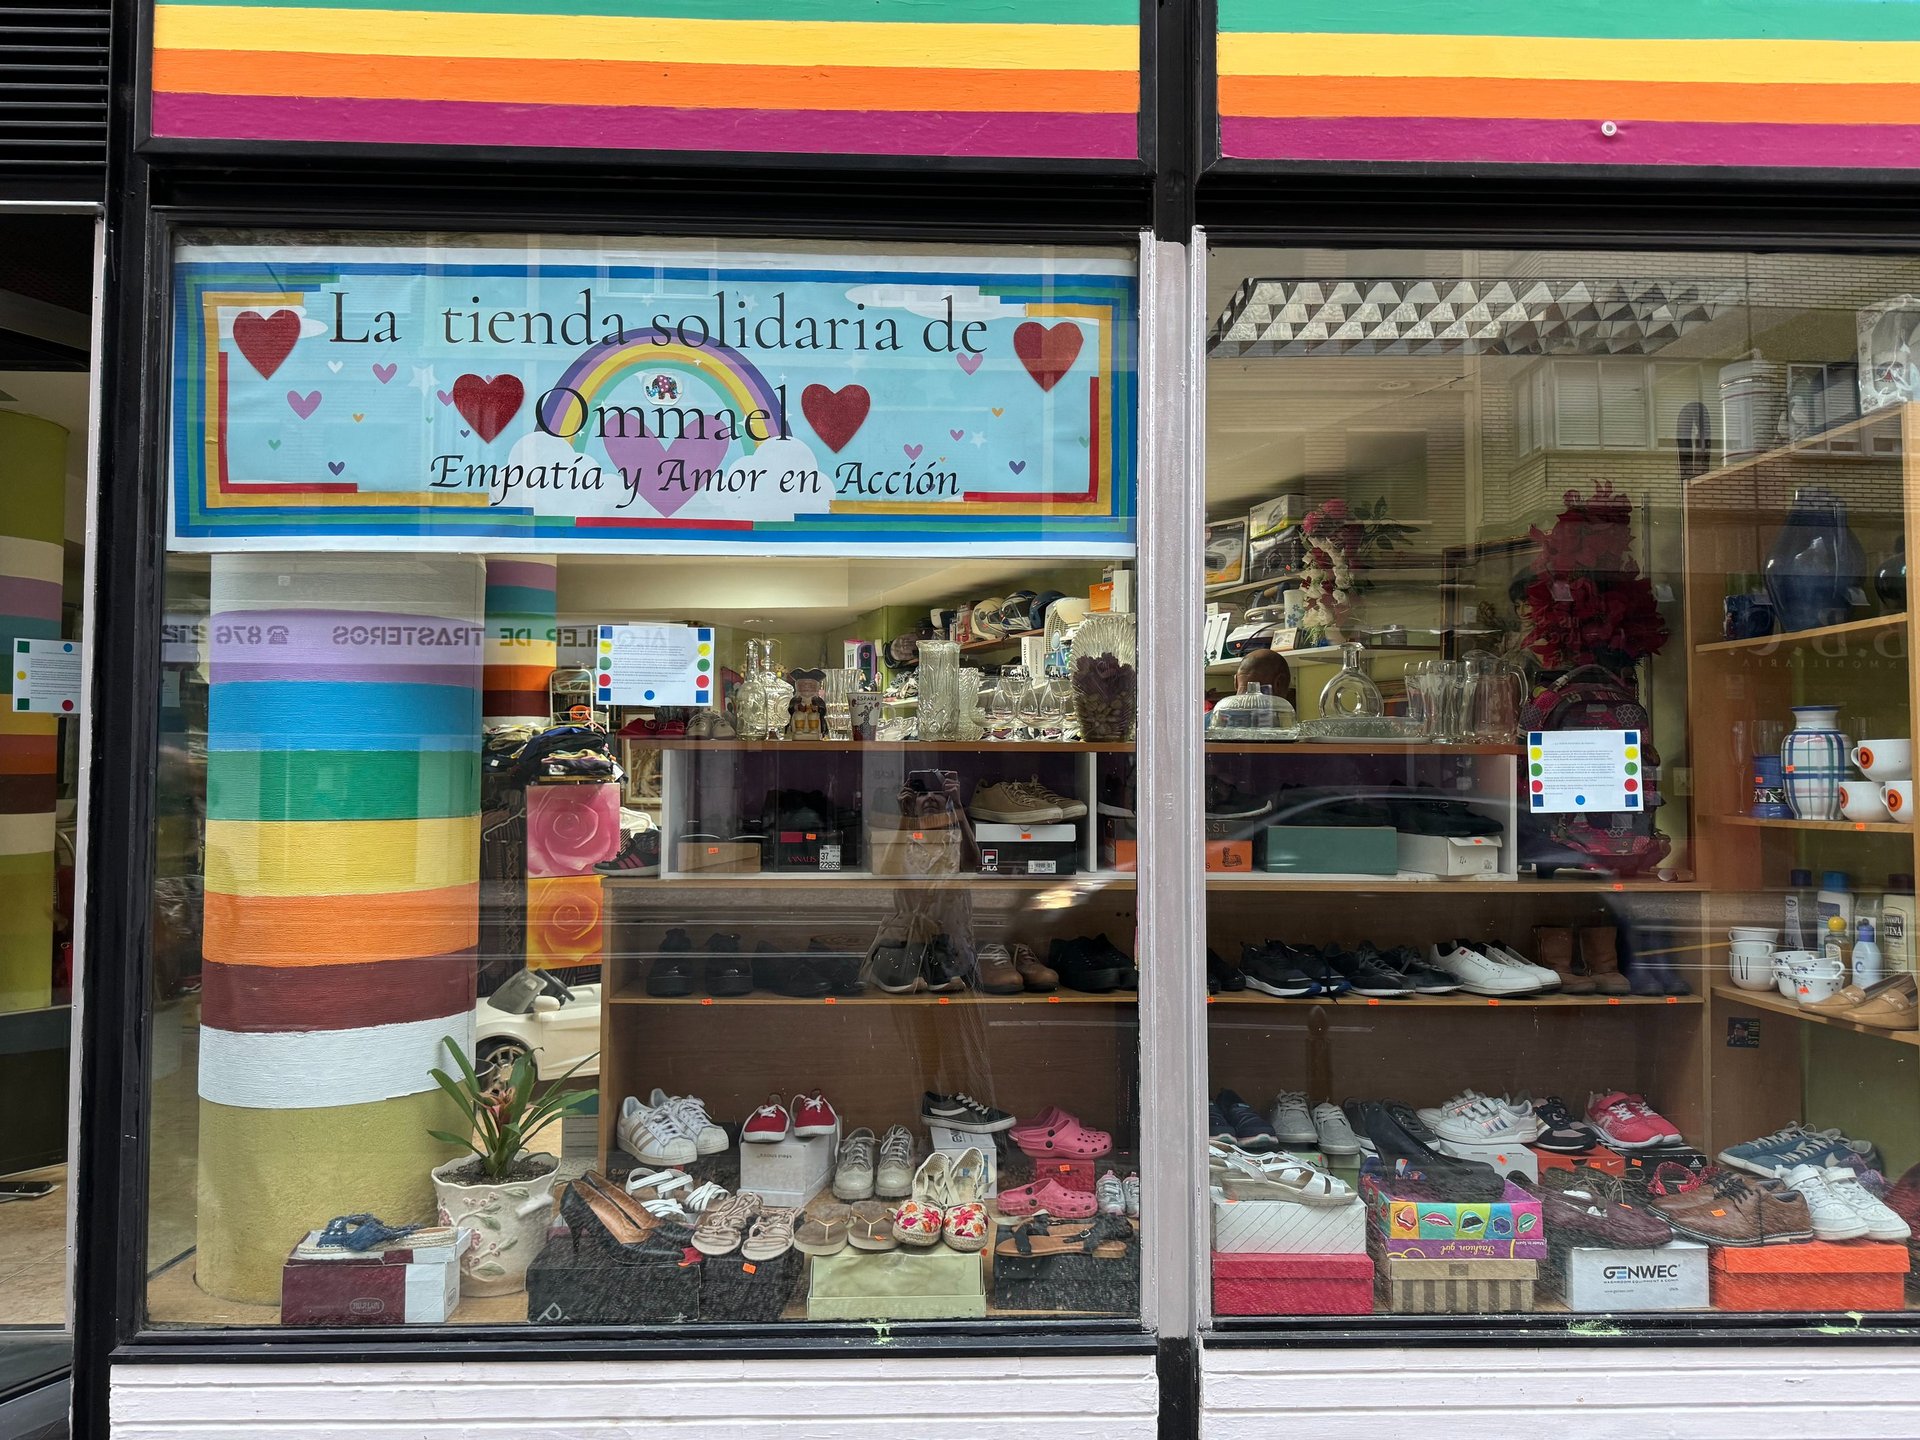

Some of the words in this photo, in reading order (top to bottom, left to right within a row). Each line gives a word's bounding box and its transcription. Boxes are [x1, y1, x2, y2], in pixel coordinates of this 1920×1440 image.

[329, 291, 402, 343] La
[441, 287, 630, 346] tienda
[650, 290, 904, 351] solidaria
[922, 294, 988, 354] de
[535, 384, 792, 442] Ommael
[429, 454, 604, 506] Empatía
[614, 466, 641, 508] y
[657, 459, 767, 493] Amor
[779, 468, 821, 494] en
[835, 461, 960, 495] Acción
[820, 852, 829, 861] 37
[1440, 1241, 1456, 1256] girl
[1459, 1245, 1495, 1256] Fashion
[1603, 1264, 1678, 1280] GENWEC
